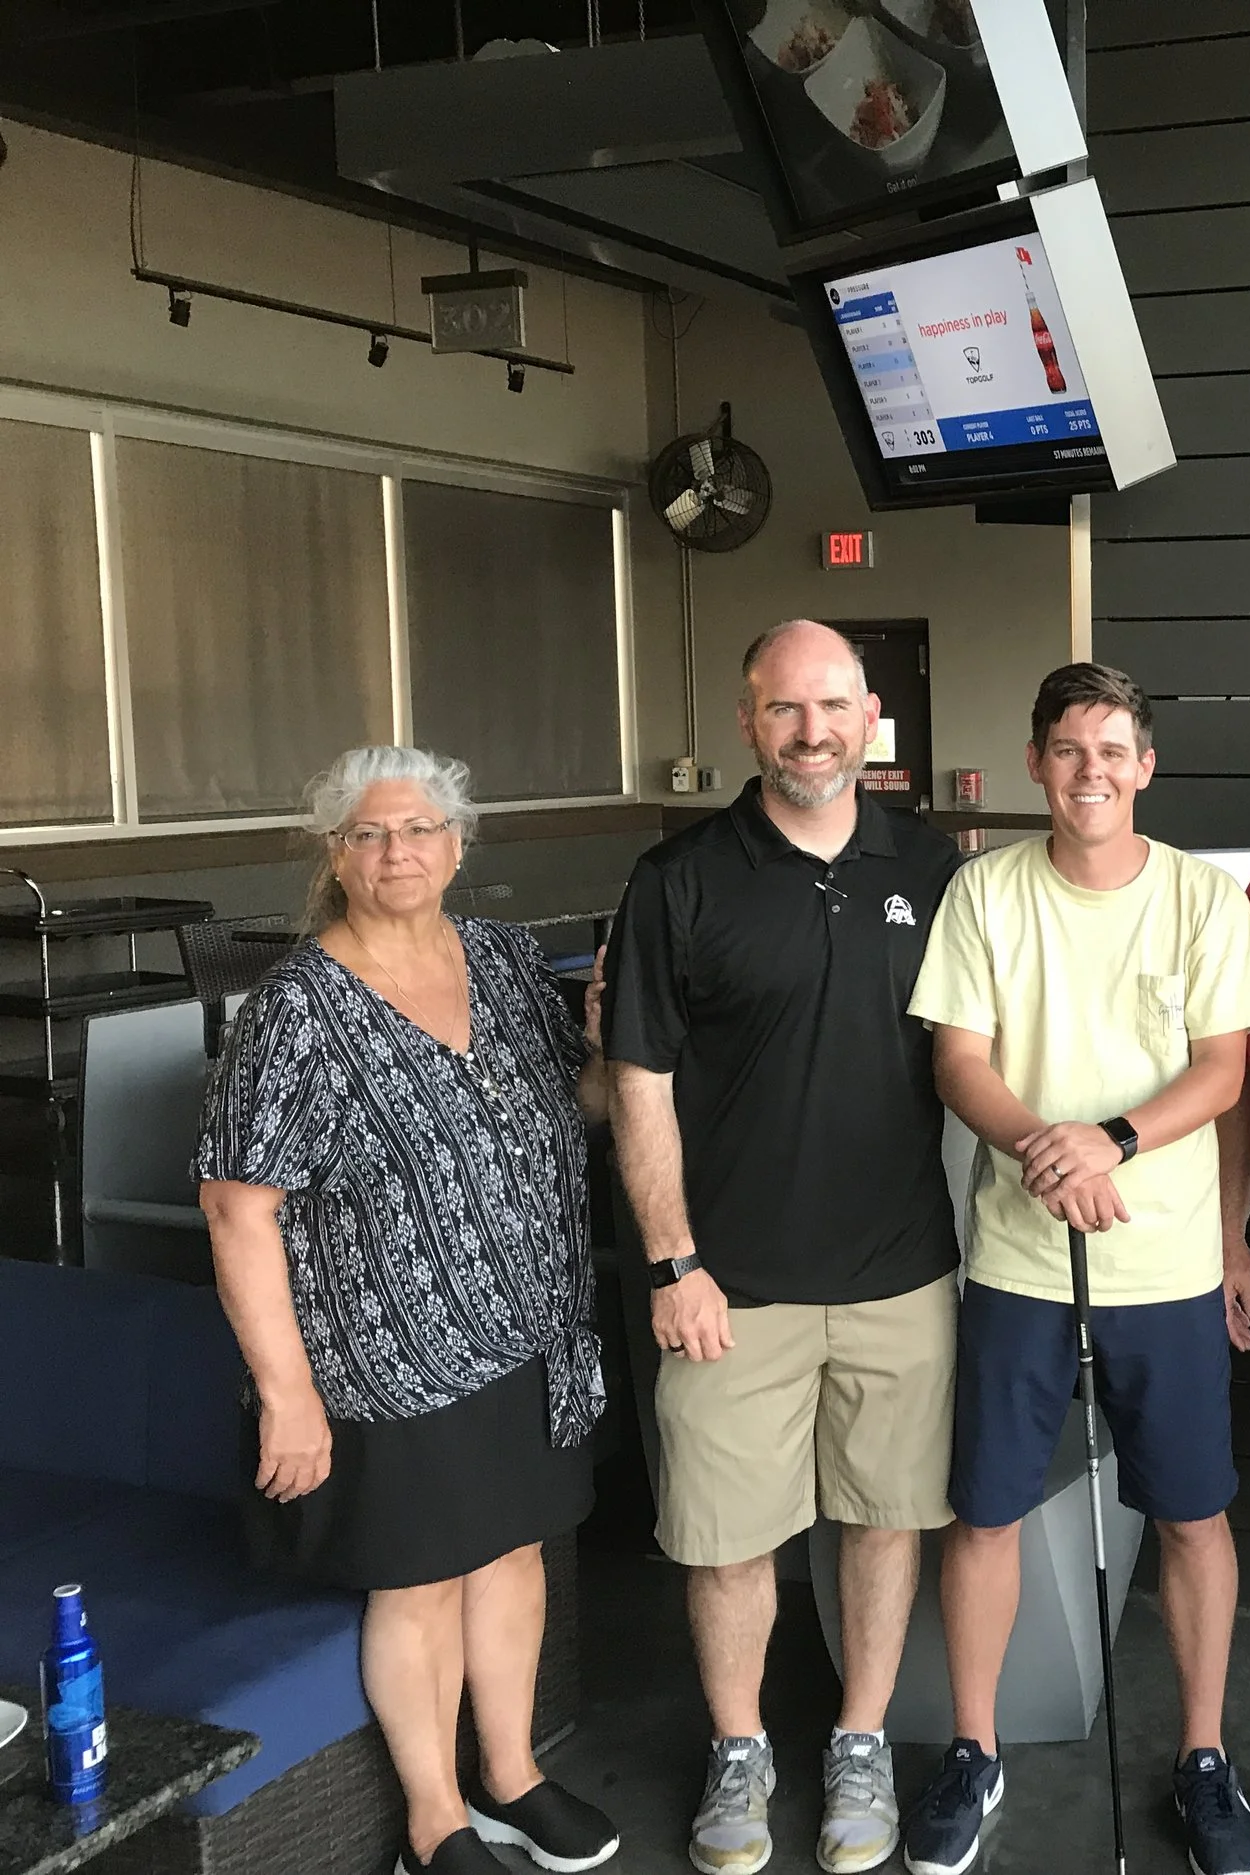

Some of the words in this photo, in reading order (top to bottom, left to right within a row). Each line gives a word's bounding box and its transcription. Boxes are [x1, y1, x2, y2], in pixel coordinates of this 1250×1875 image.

[917, 317, 971, 338] happiness
[971, 313, 983, 328] in
[984, 308, 1007, 328] play
[966, 373, 994, 384] TOPGOLF
[1036, 424, 1049, 435] PTS
[1069, 421, 1078, 431] 25
[1078, 419, 1092, 430] PTS
[913, 429, 936, 447] 303
[967, 432, 989, 443] PLAYER
[1060, 447, 1084, 459] MINUTES
[830, 533, 863, 563] EXIT
[888, 770, 904, 780] EXIT
[864, 781, 882, 791] WILL
[884, 781, 910, 791] SOUND
[727, 1749, 750, 1761] NIKE
[849, 1745, 872, 1756] NIKE
